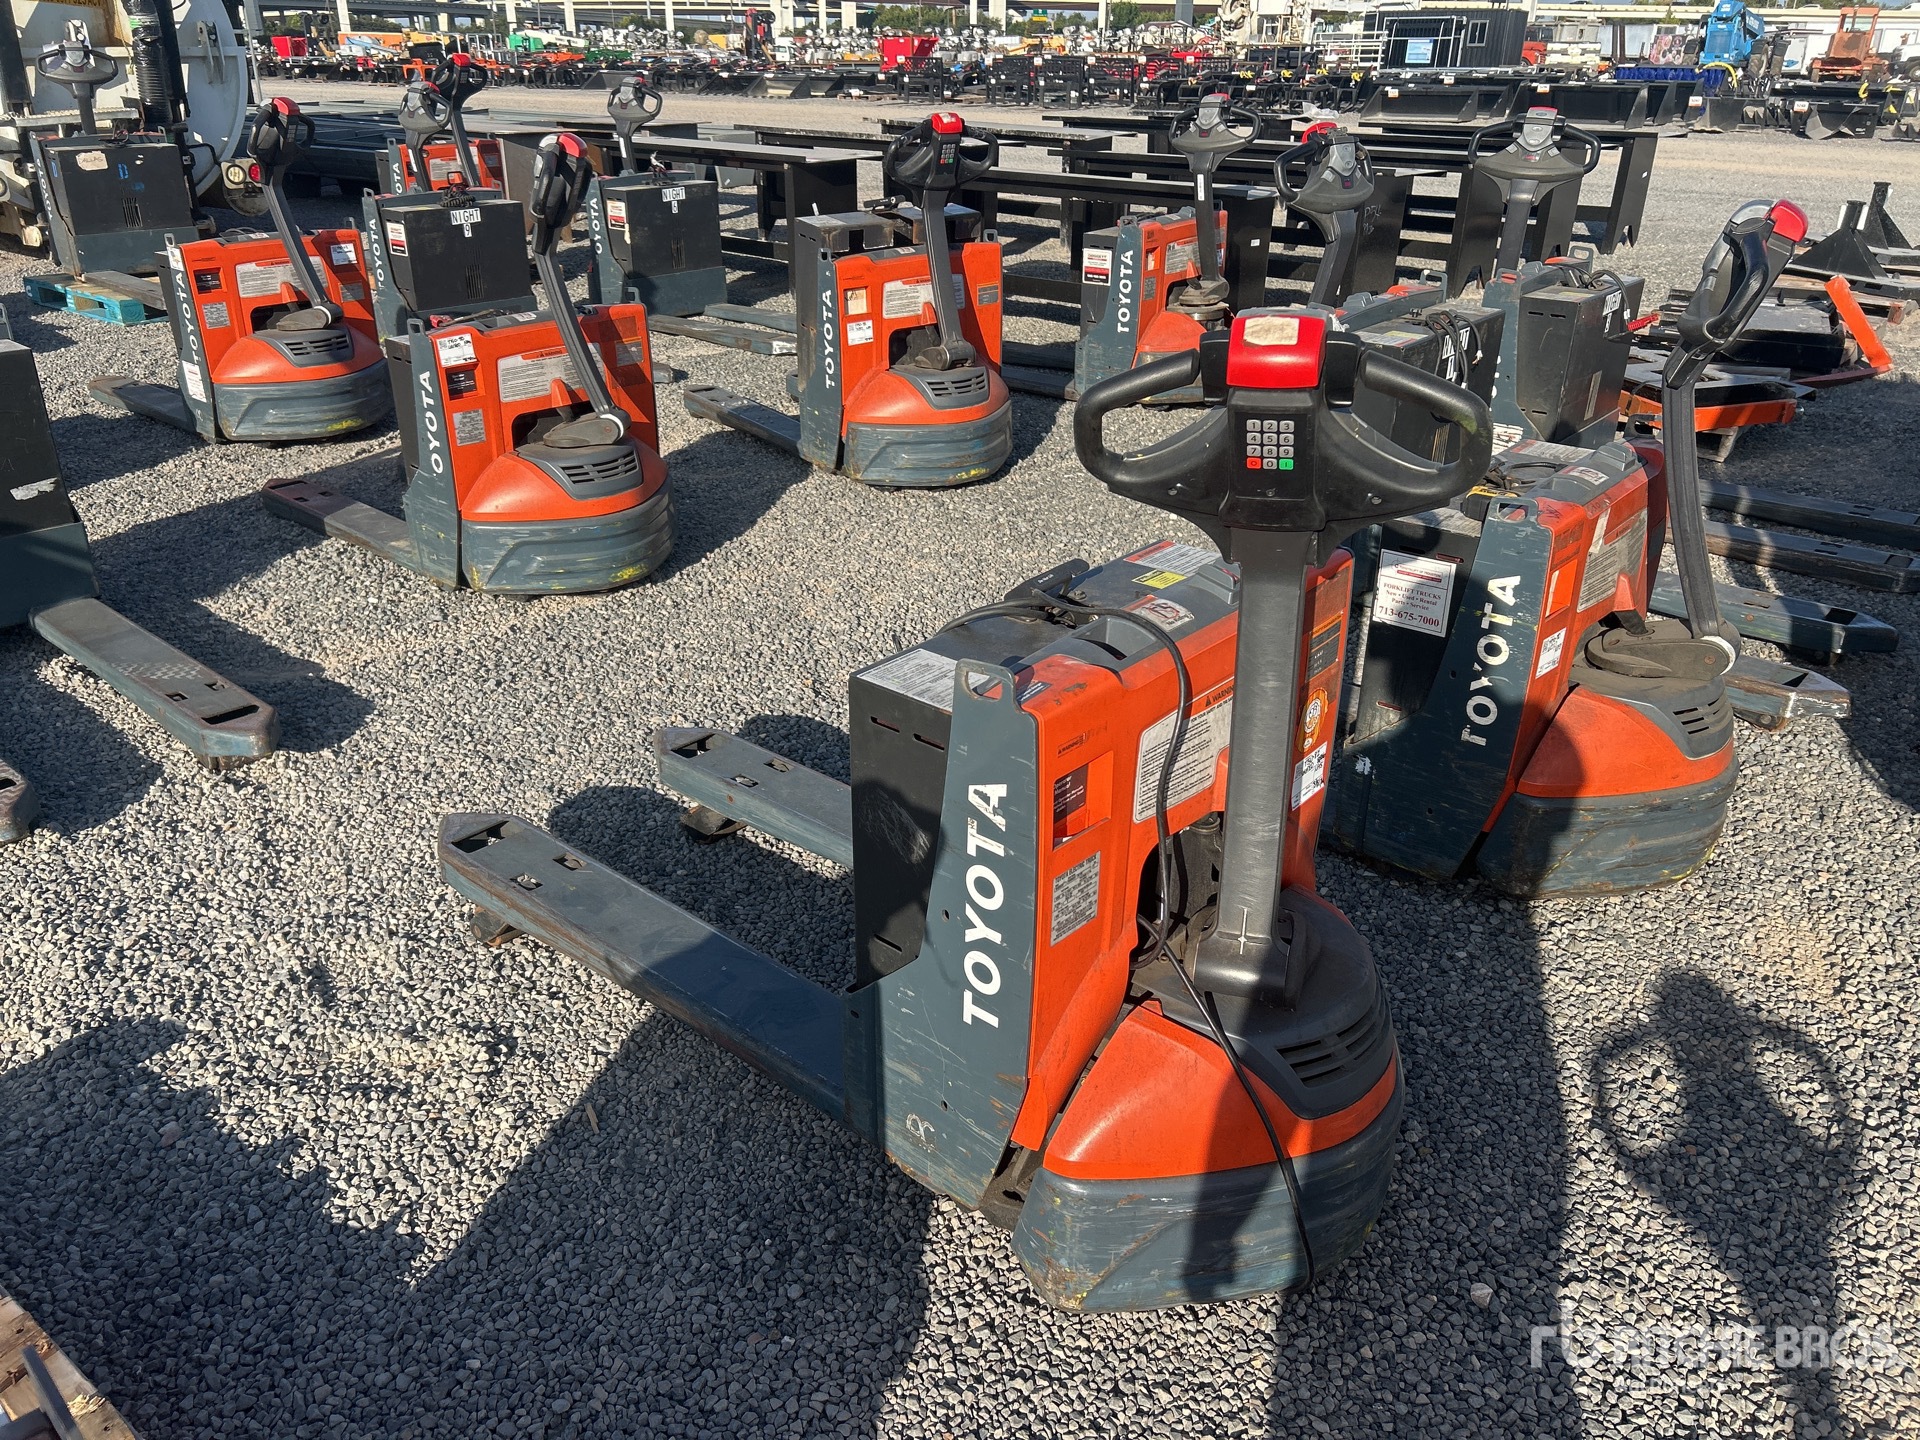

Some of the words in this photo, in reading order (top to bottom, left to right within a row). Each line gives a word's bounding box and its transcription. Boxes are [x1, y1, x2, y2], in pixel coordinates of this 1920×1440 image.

[662, 187, 685, 201] NIGHT
[451, 209, 479, 224] NIGHT
[1117, 250, 1134, 334] TOYOTA
[822, 289, 836, 389] TOYOTA
[1284, 423, 1290, 431] 3
[1267, 435, 1273, 443] 5
[1251, 447, 1257, 455] 7
[1267, 448, 1273, 456] 8
[1283, 448, 1290, 456] 9
[1383, 582, 1415, 594] FORKLIFT
[1416, 589, 1442, 600] TRUCKS
[1401, 593, 1415, 601] Used
[1417, 598, 1438, 606] Rental
[1410, 600, 1430, 611] Service
[1379, 606, 1440, 628] 713-675-7000
[1460, 575, 1521, 747] TOYOTA
[963, 783, 1007, 1029] TOYOTA
